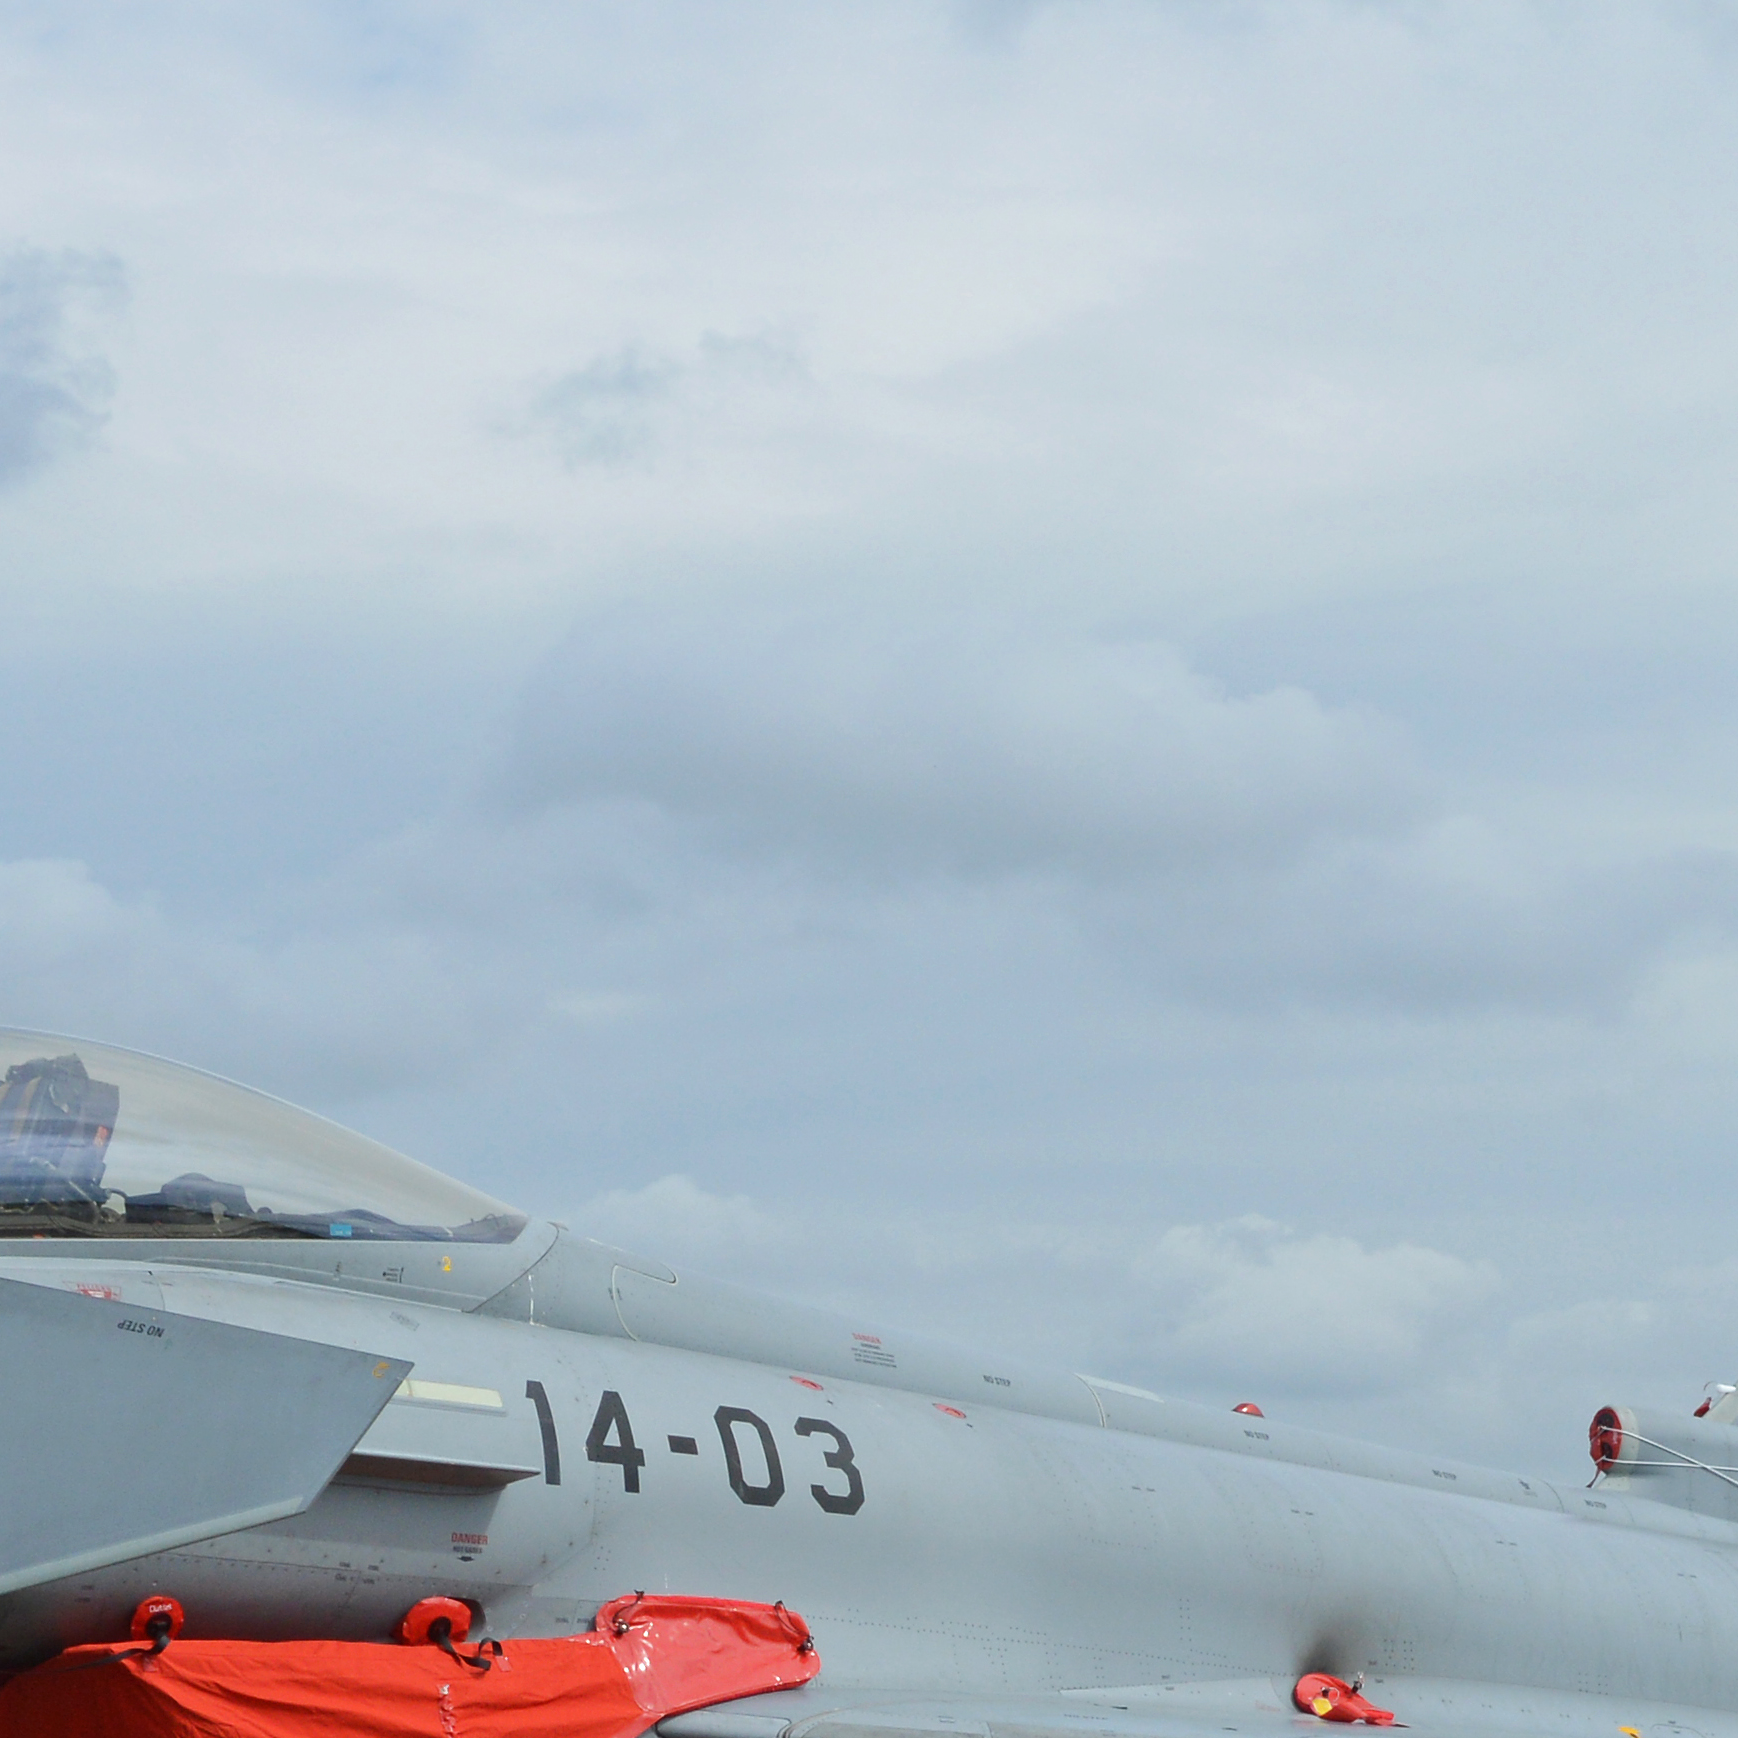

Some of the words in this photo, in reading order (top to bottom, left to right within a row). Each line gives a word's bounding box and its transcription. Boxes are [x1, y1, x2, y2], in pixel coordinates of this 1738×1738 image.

[117, 1319, 146, 1334] STEP
[147, 1325, 165, 1338] NO
[525, 1379, 865, 1516] 14-03
[451, 1532, 488, 1545] DANGER
